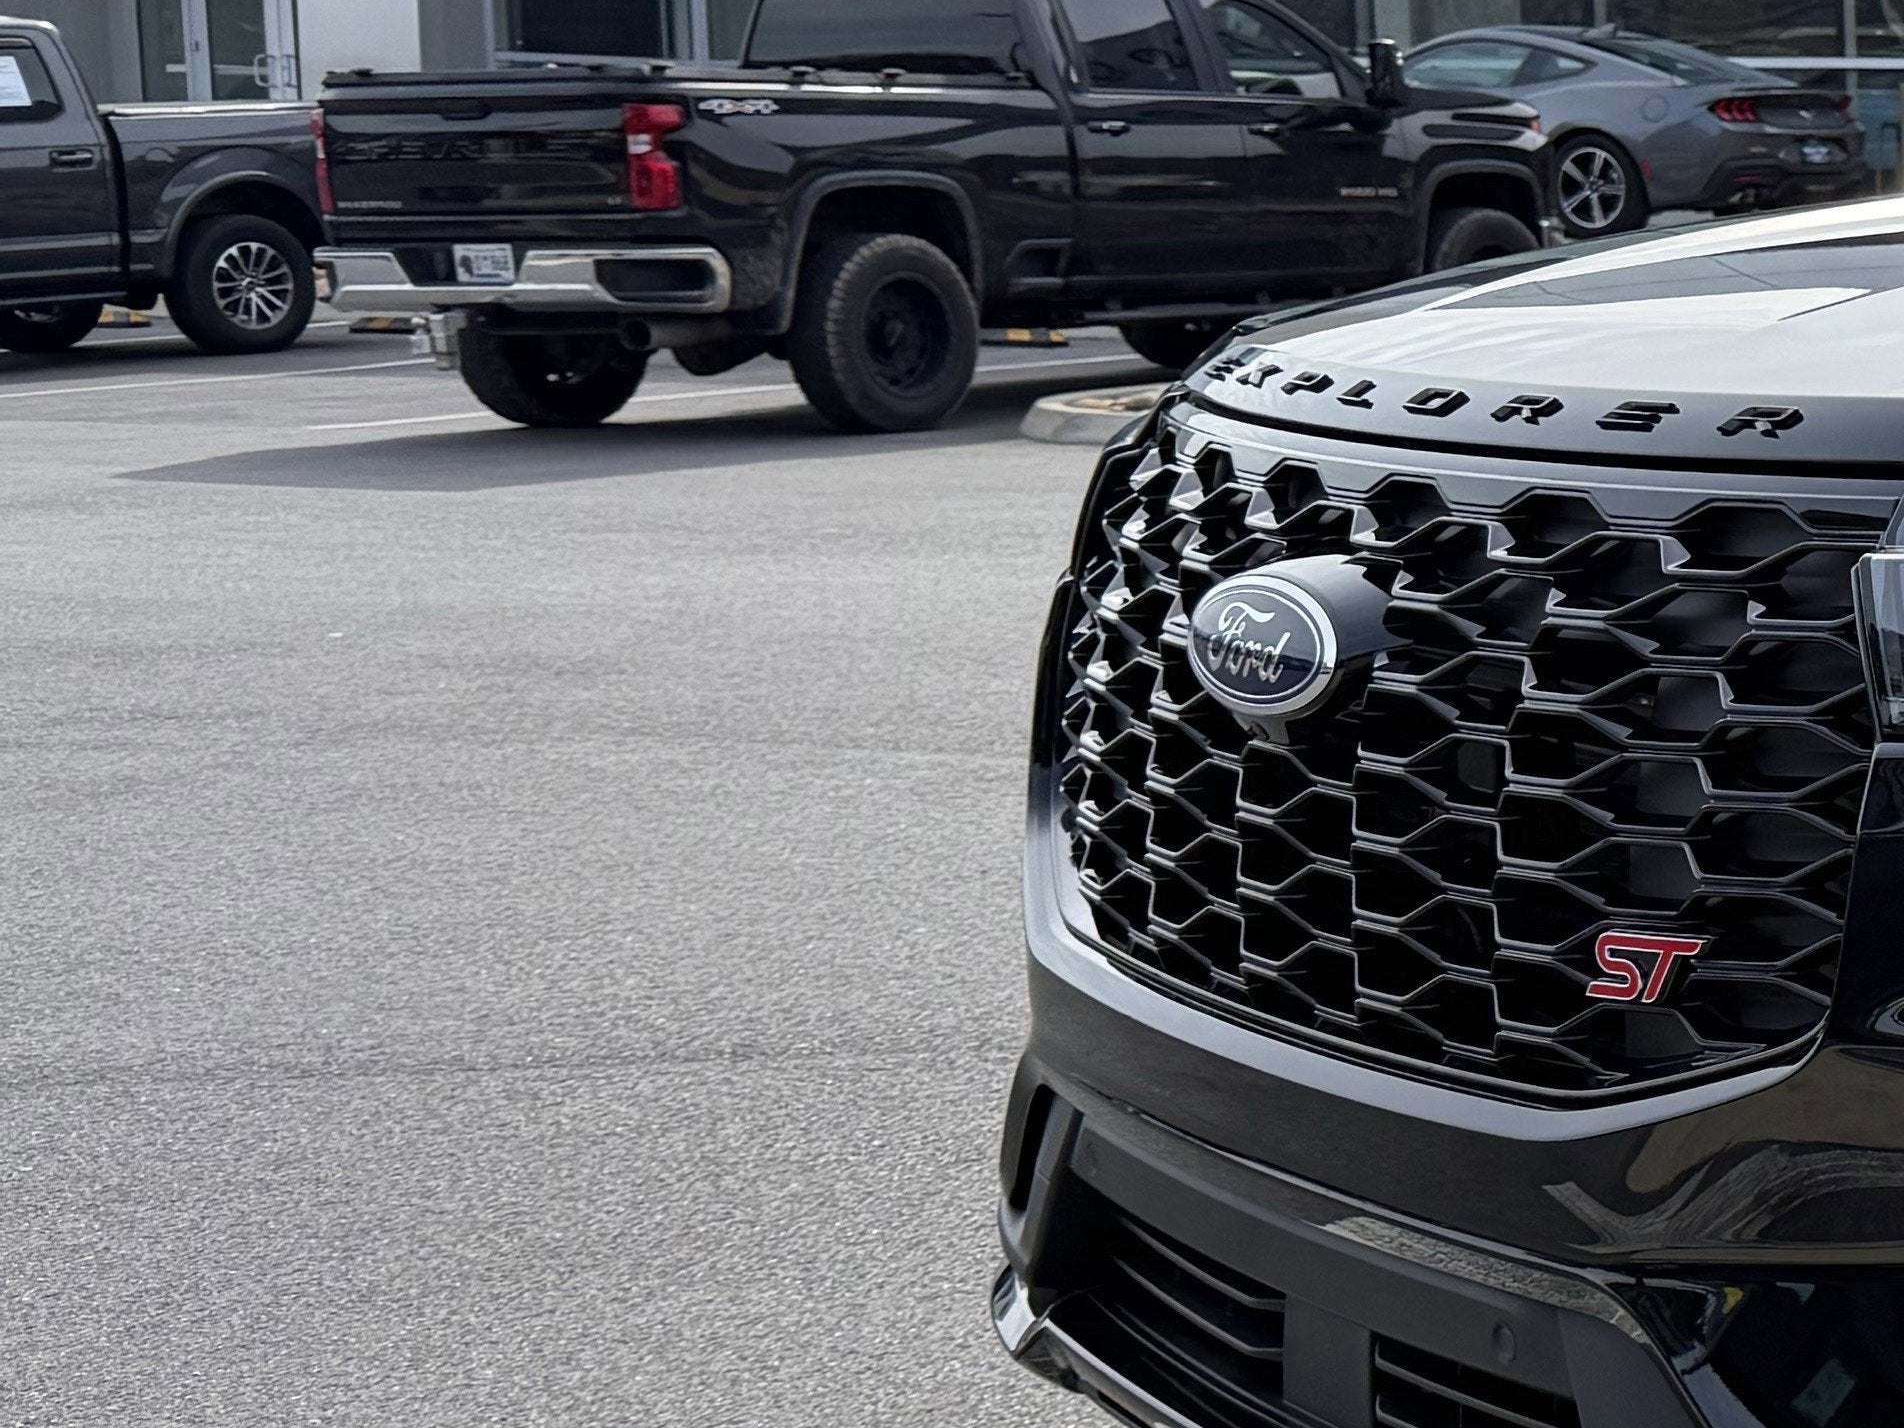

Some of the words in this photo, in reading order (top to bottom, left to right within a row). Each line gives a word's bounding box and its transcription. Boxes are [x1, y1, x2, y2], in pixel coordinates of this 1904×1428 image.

[1203, 357, 1806, 440] EXPLORER
[1208, 601, 1291, 684] Ford
[1585, 930, 1712, 1004] ST
